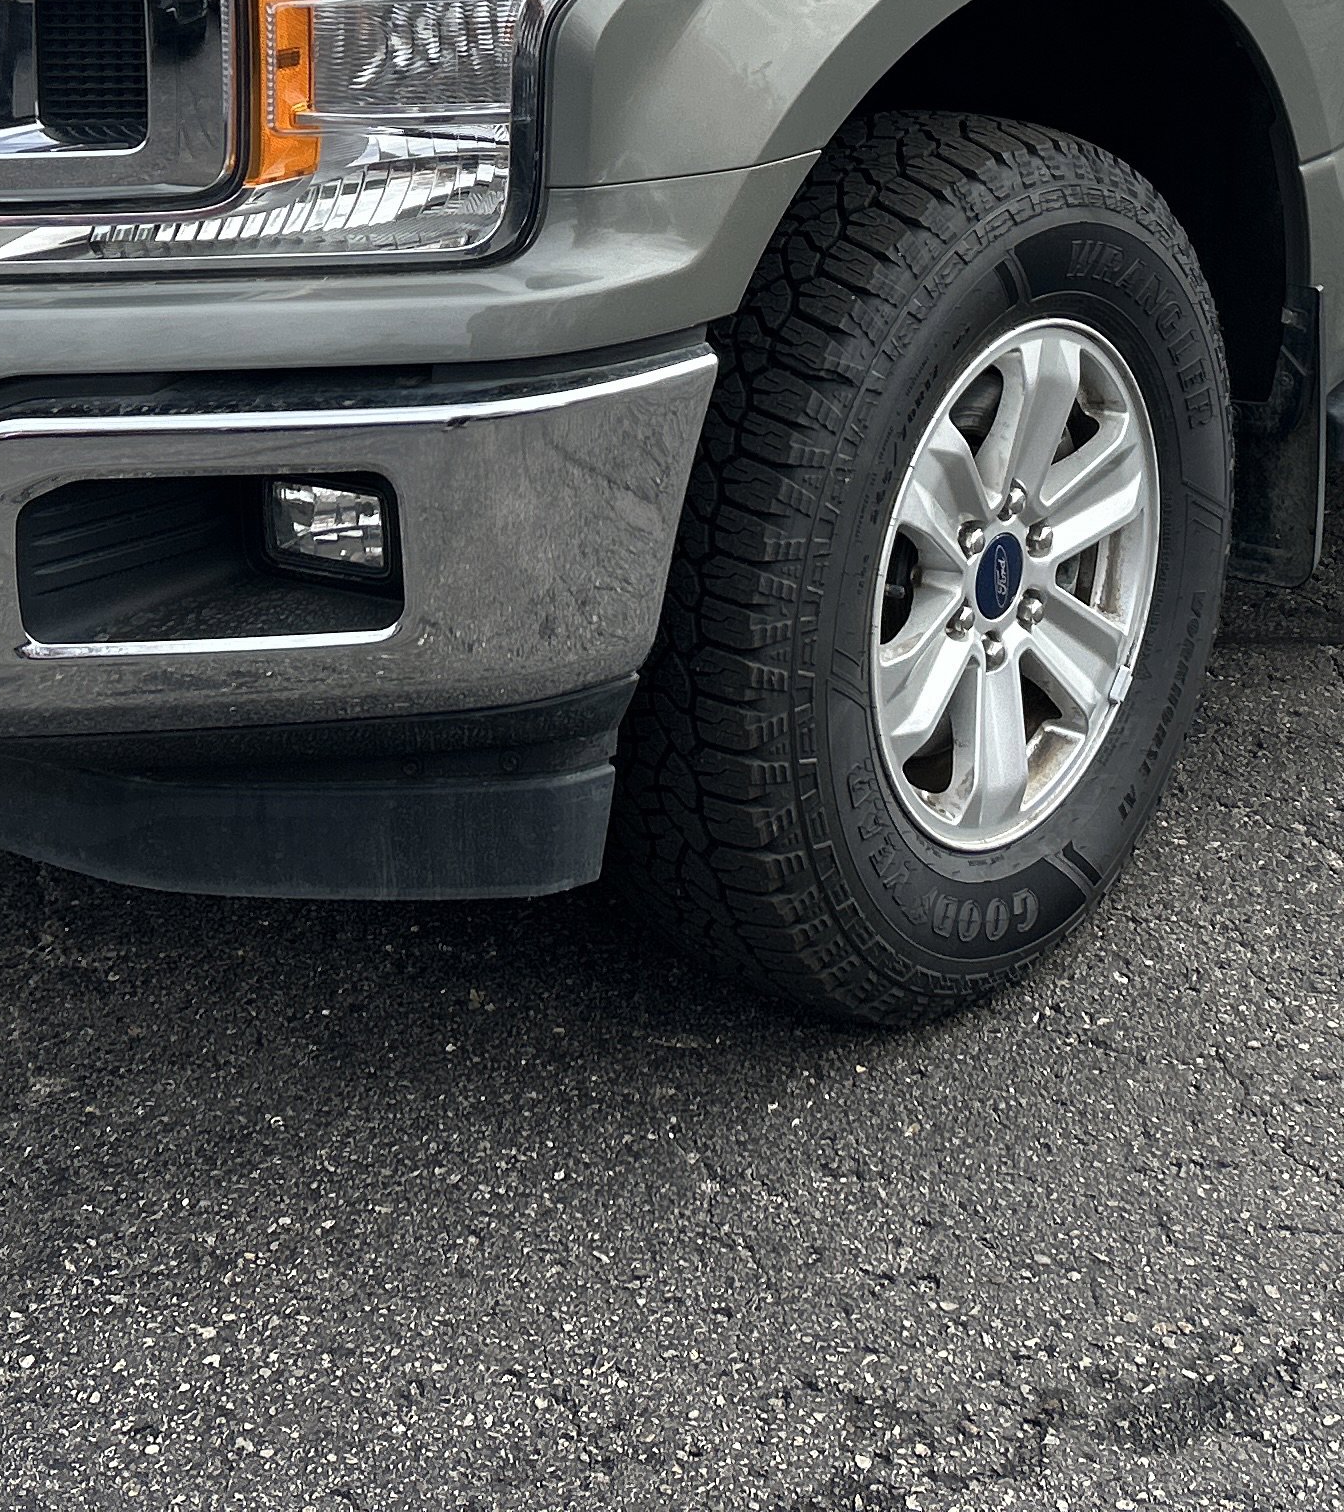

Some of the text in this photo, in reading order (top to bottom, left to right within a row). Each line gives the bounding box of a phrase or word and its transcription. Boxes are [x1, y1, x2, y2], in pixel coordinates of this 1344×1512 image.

[1066, 239, 1214, 429] WRANGLER
[1138, 591, 1205, 779] WORKHORSE
[1117, 784, 1137, 825] AT
